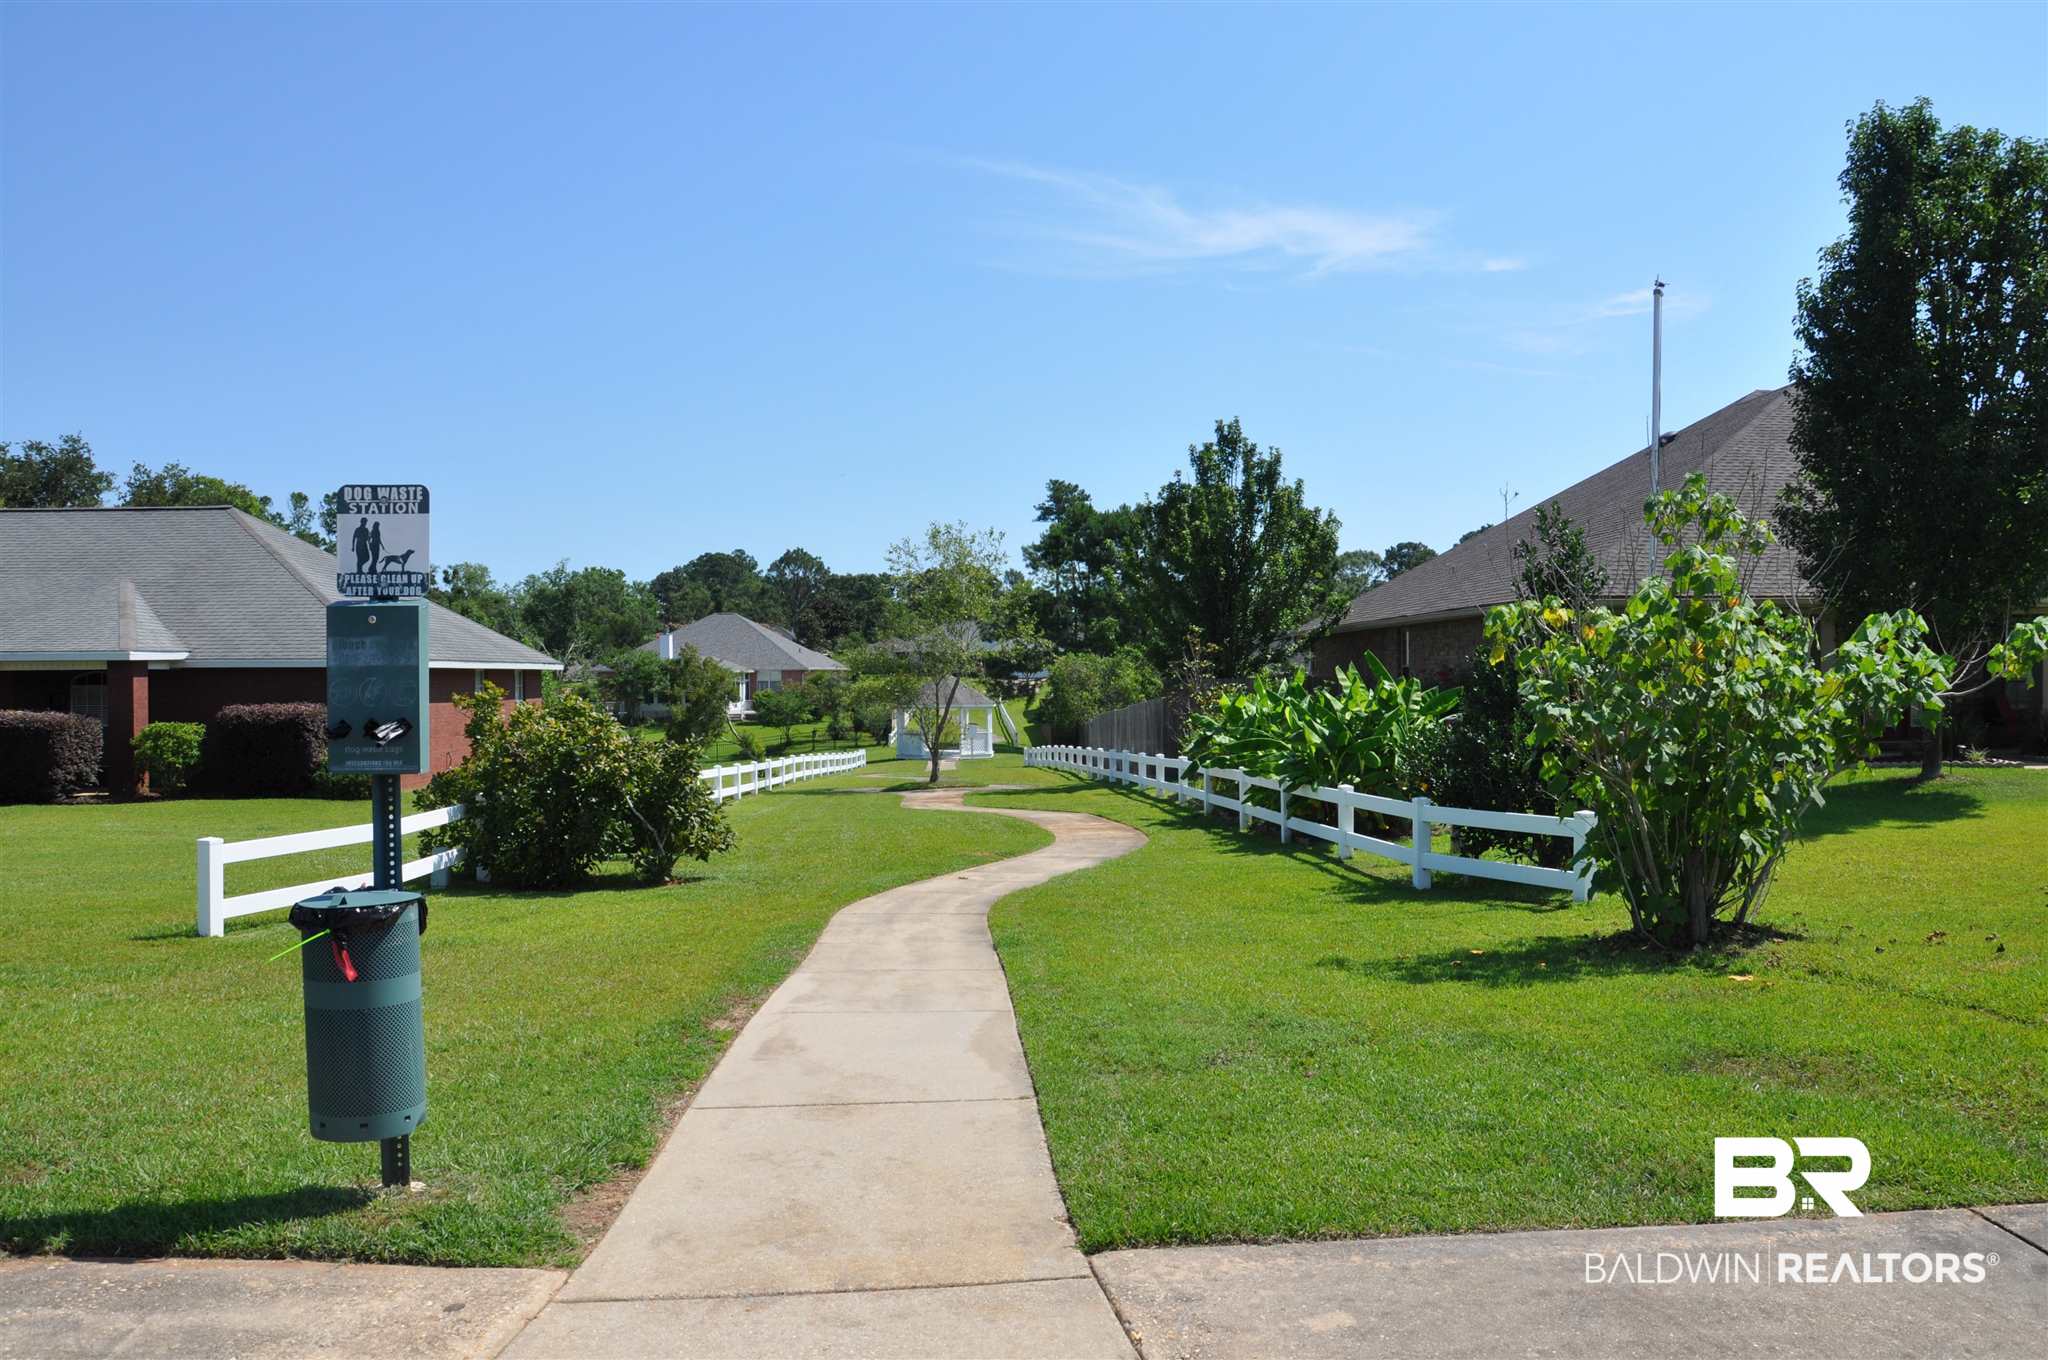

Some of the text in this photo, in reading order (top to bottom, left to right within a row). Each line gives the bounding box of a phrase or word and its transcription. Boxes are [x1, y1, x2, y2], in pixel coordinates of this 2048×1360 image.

[343, 487, 423, 501] DOG WASTE
[348, 502, 419, 514] STATION
[344, 574, 423, 584] PLEASE CLEAN UP
[345, 586, 422, 596] AFTER YOUR DOG
